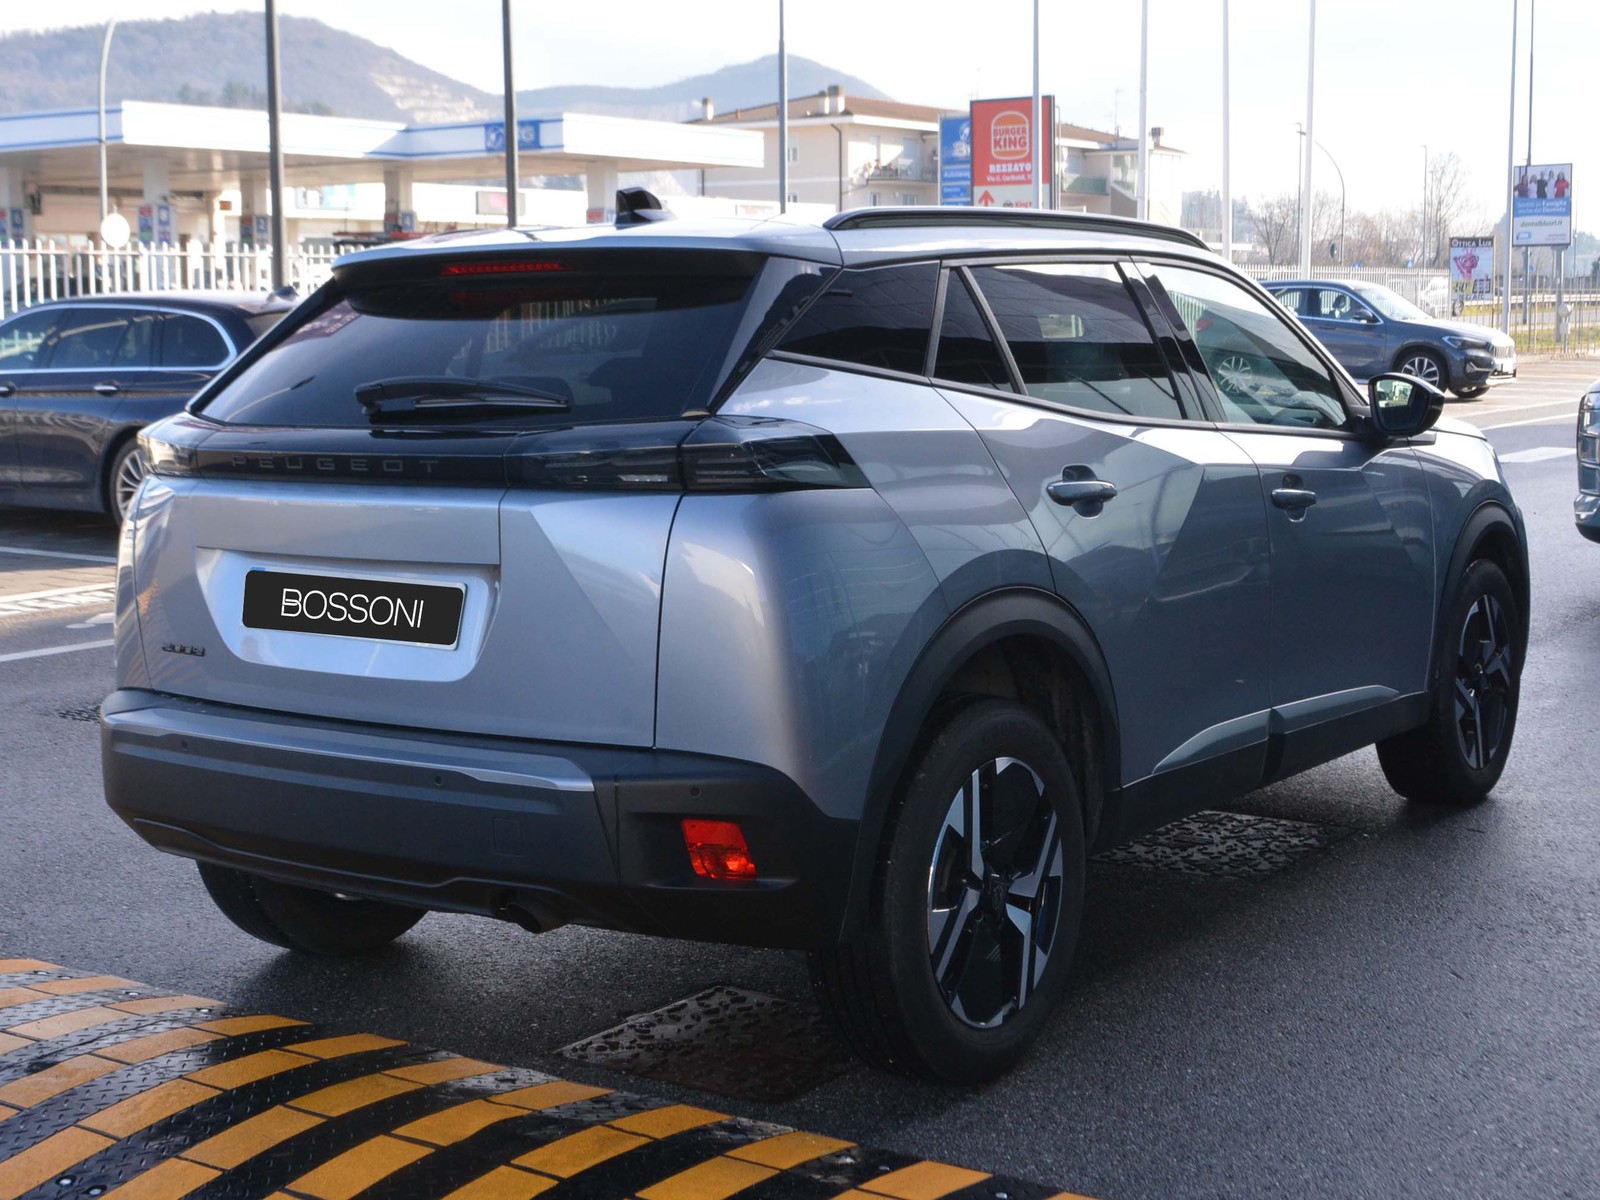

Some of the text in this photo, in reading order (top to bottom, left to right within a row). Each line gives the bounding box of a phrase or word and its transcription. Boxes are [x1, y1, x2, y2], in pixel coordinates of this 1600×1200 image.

[993, 126, 1027, 137] BURGER
[993, 137, 1028, 151] KING
[232, 456, 440, 473] PEUGEOT
[280, 588, 425, 628] BOSSONI
